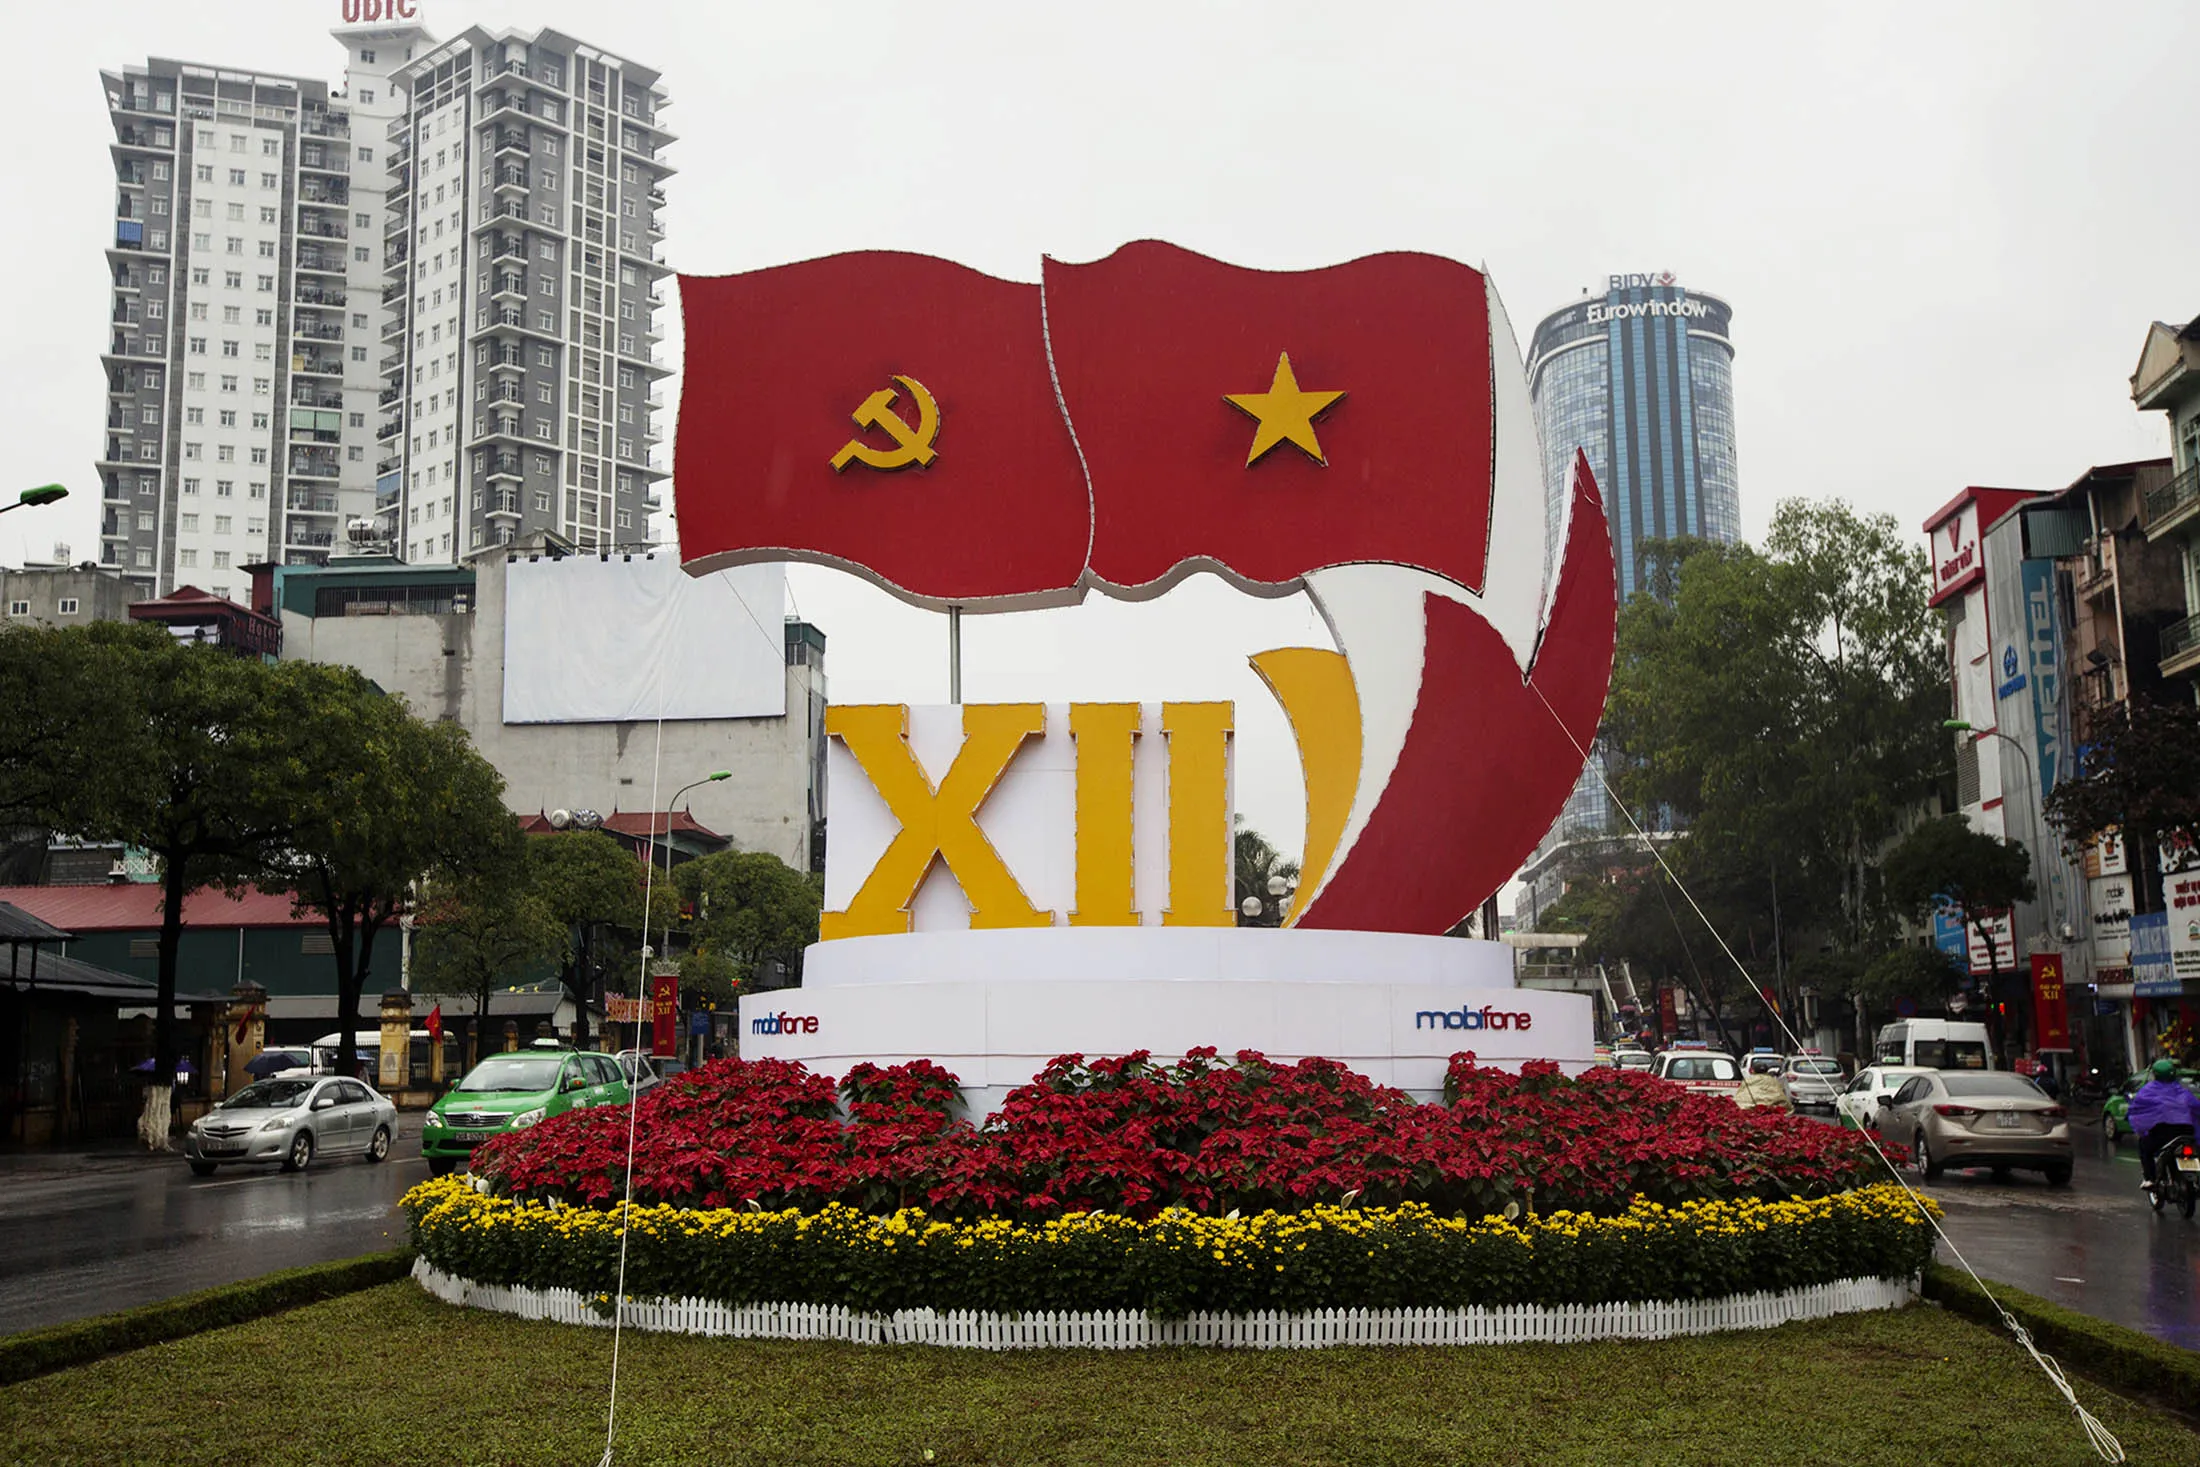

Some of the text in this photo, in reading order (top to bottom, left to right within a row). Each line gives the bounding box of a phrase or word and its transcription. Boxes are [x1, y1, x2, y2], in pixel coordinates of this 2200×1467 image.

[342, 0, 417, 23] UDIC
[1609, 273, 1655, 290] BIDV
[1586, 298, 1707, 324] Eurowindow
[820, 701, 1238, 941] XII
[2042, 990, 2059, 1000] XII
[752, 1011, 819, 1035] mobifone
[1416, 1005, 1511, 1030] mobifone
